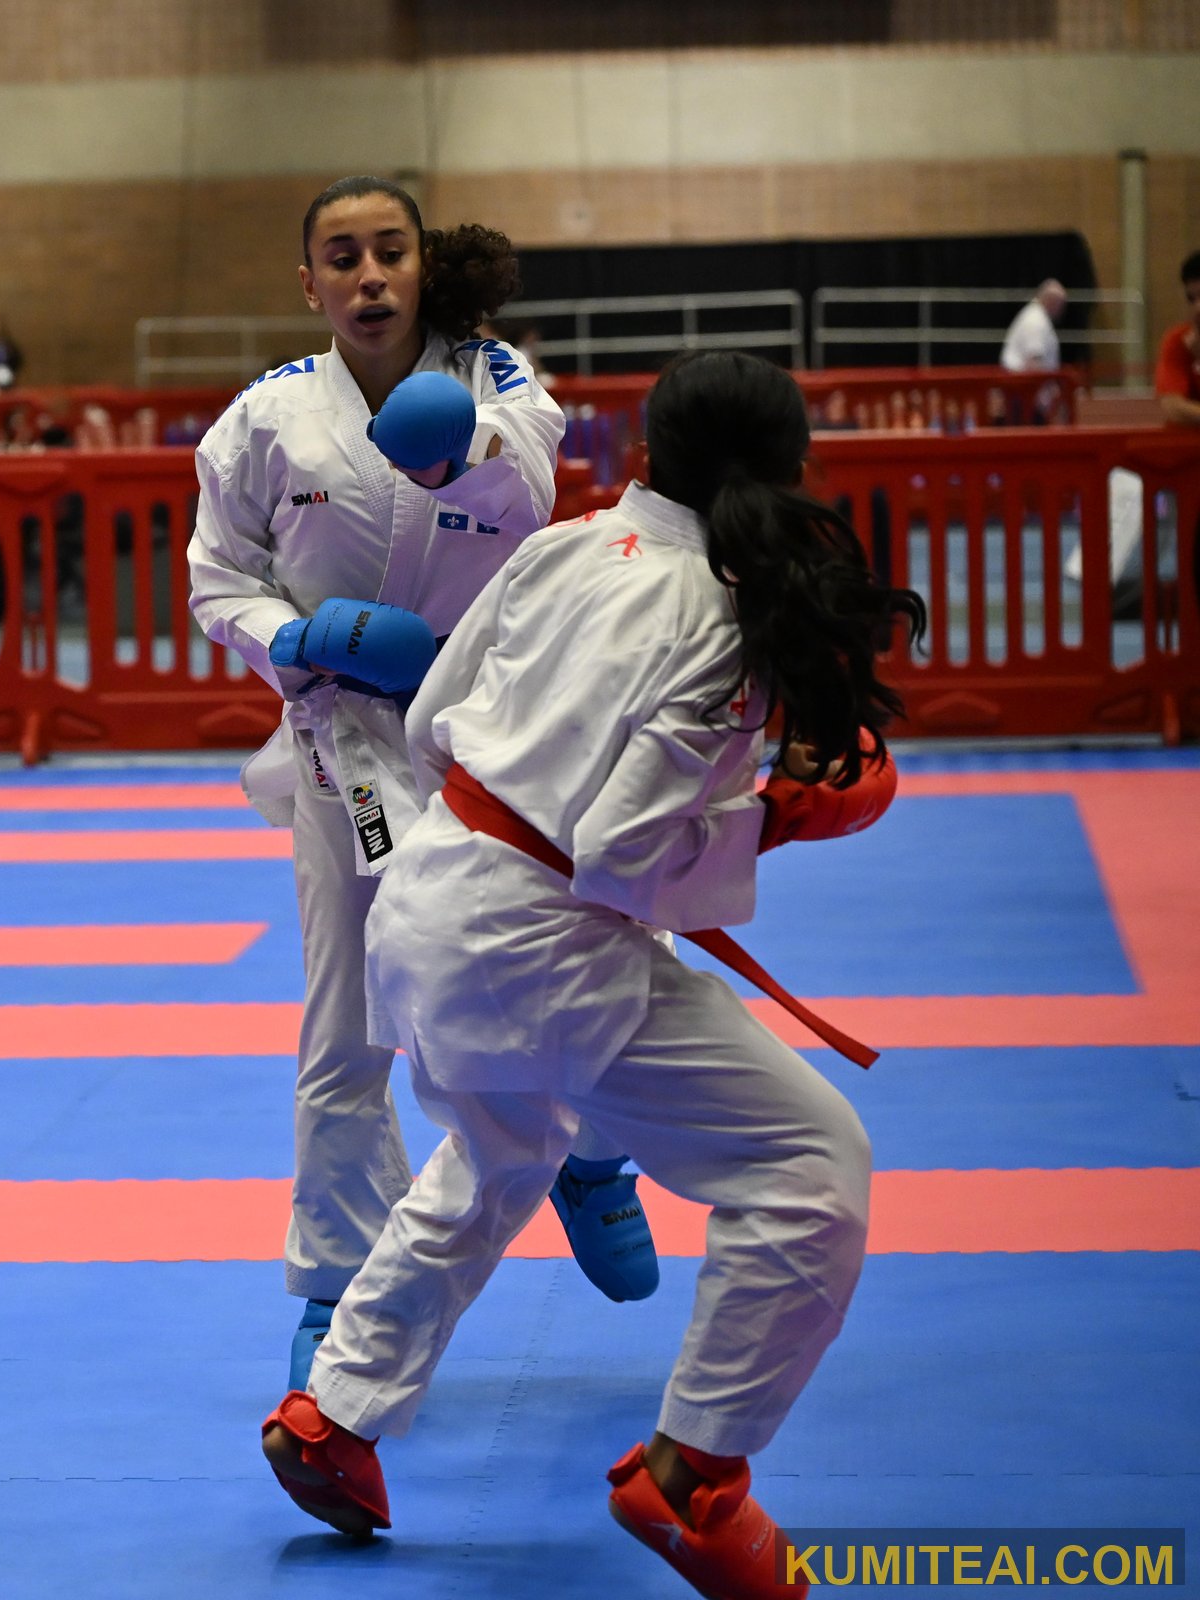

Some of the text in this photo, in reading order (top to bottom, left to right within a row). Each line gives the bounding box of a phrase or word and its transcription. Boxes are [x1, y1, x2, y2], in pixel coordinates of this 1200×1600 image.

[291, 490, 329, 506] SMAI
[348, 610, 371, 655] SMAI
[359, 811, 379, 824] SMAI
[365, 827, 385, 854] JIN
[602, 1206, 642, 1226] SMAI
